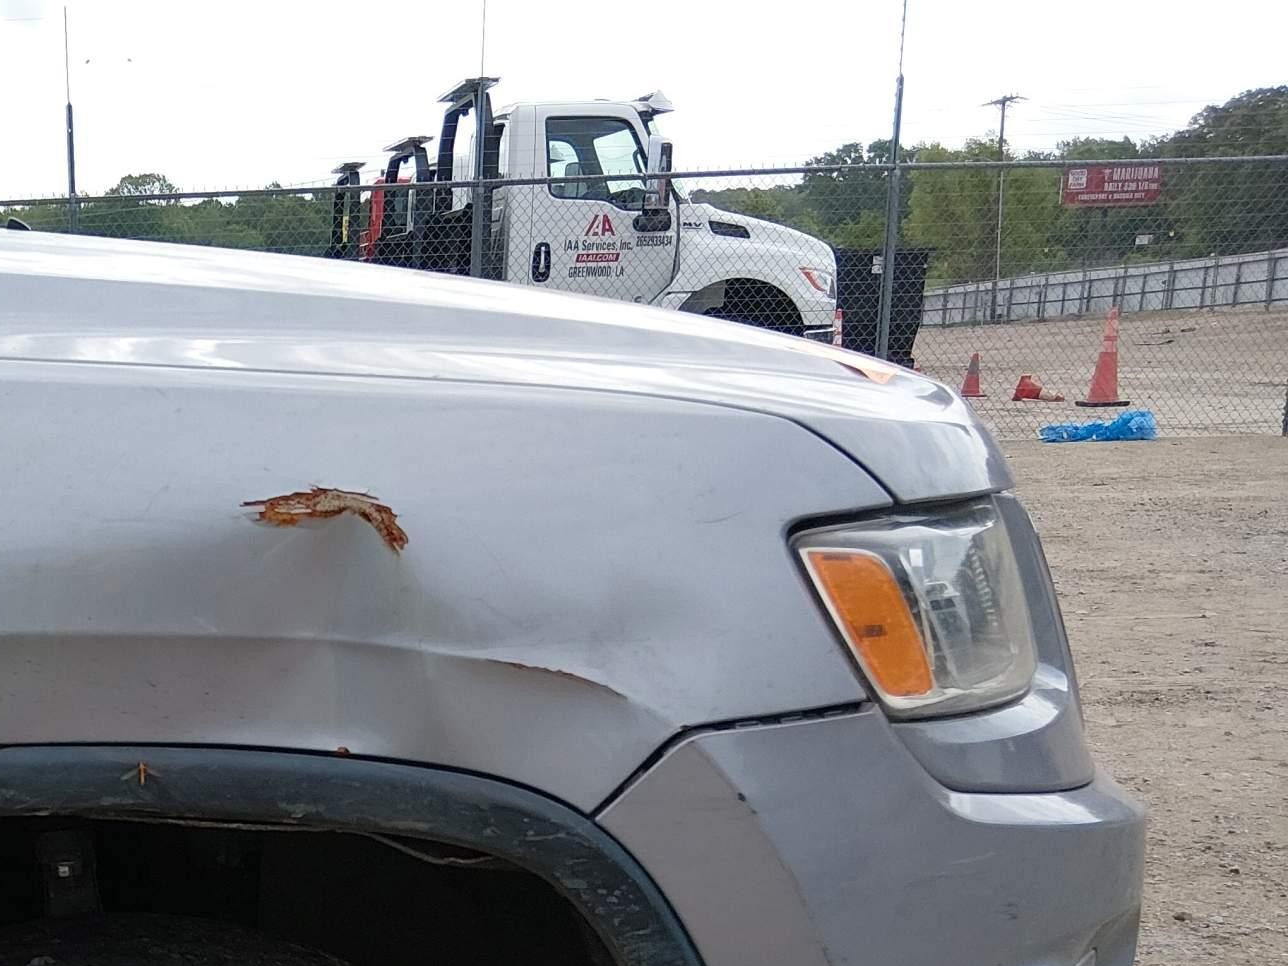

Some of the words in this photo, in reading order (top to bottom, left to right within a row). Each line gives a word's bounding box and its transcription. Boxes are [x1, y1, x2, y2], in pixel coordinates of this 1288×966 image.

[1113, 167, 1159, 180] MARIJUANA
[564, 240, 579, 251] IAA
[615, 265, 624, 277] LA
